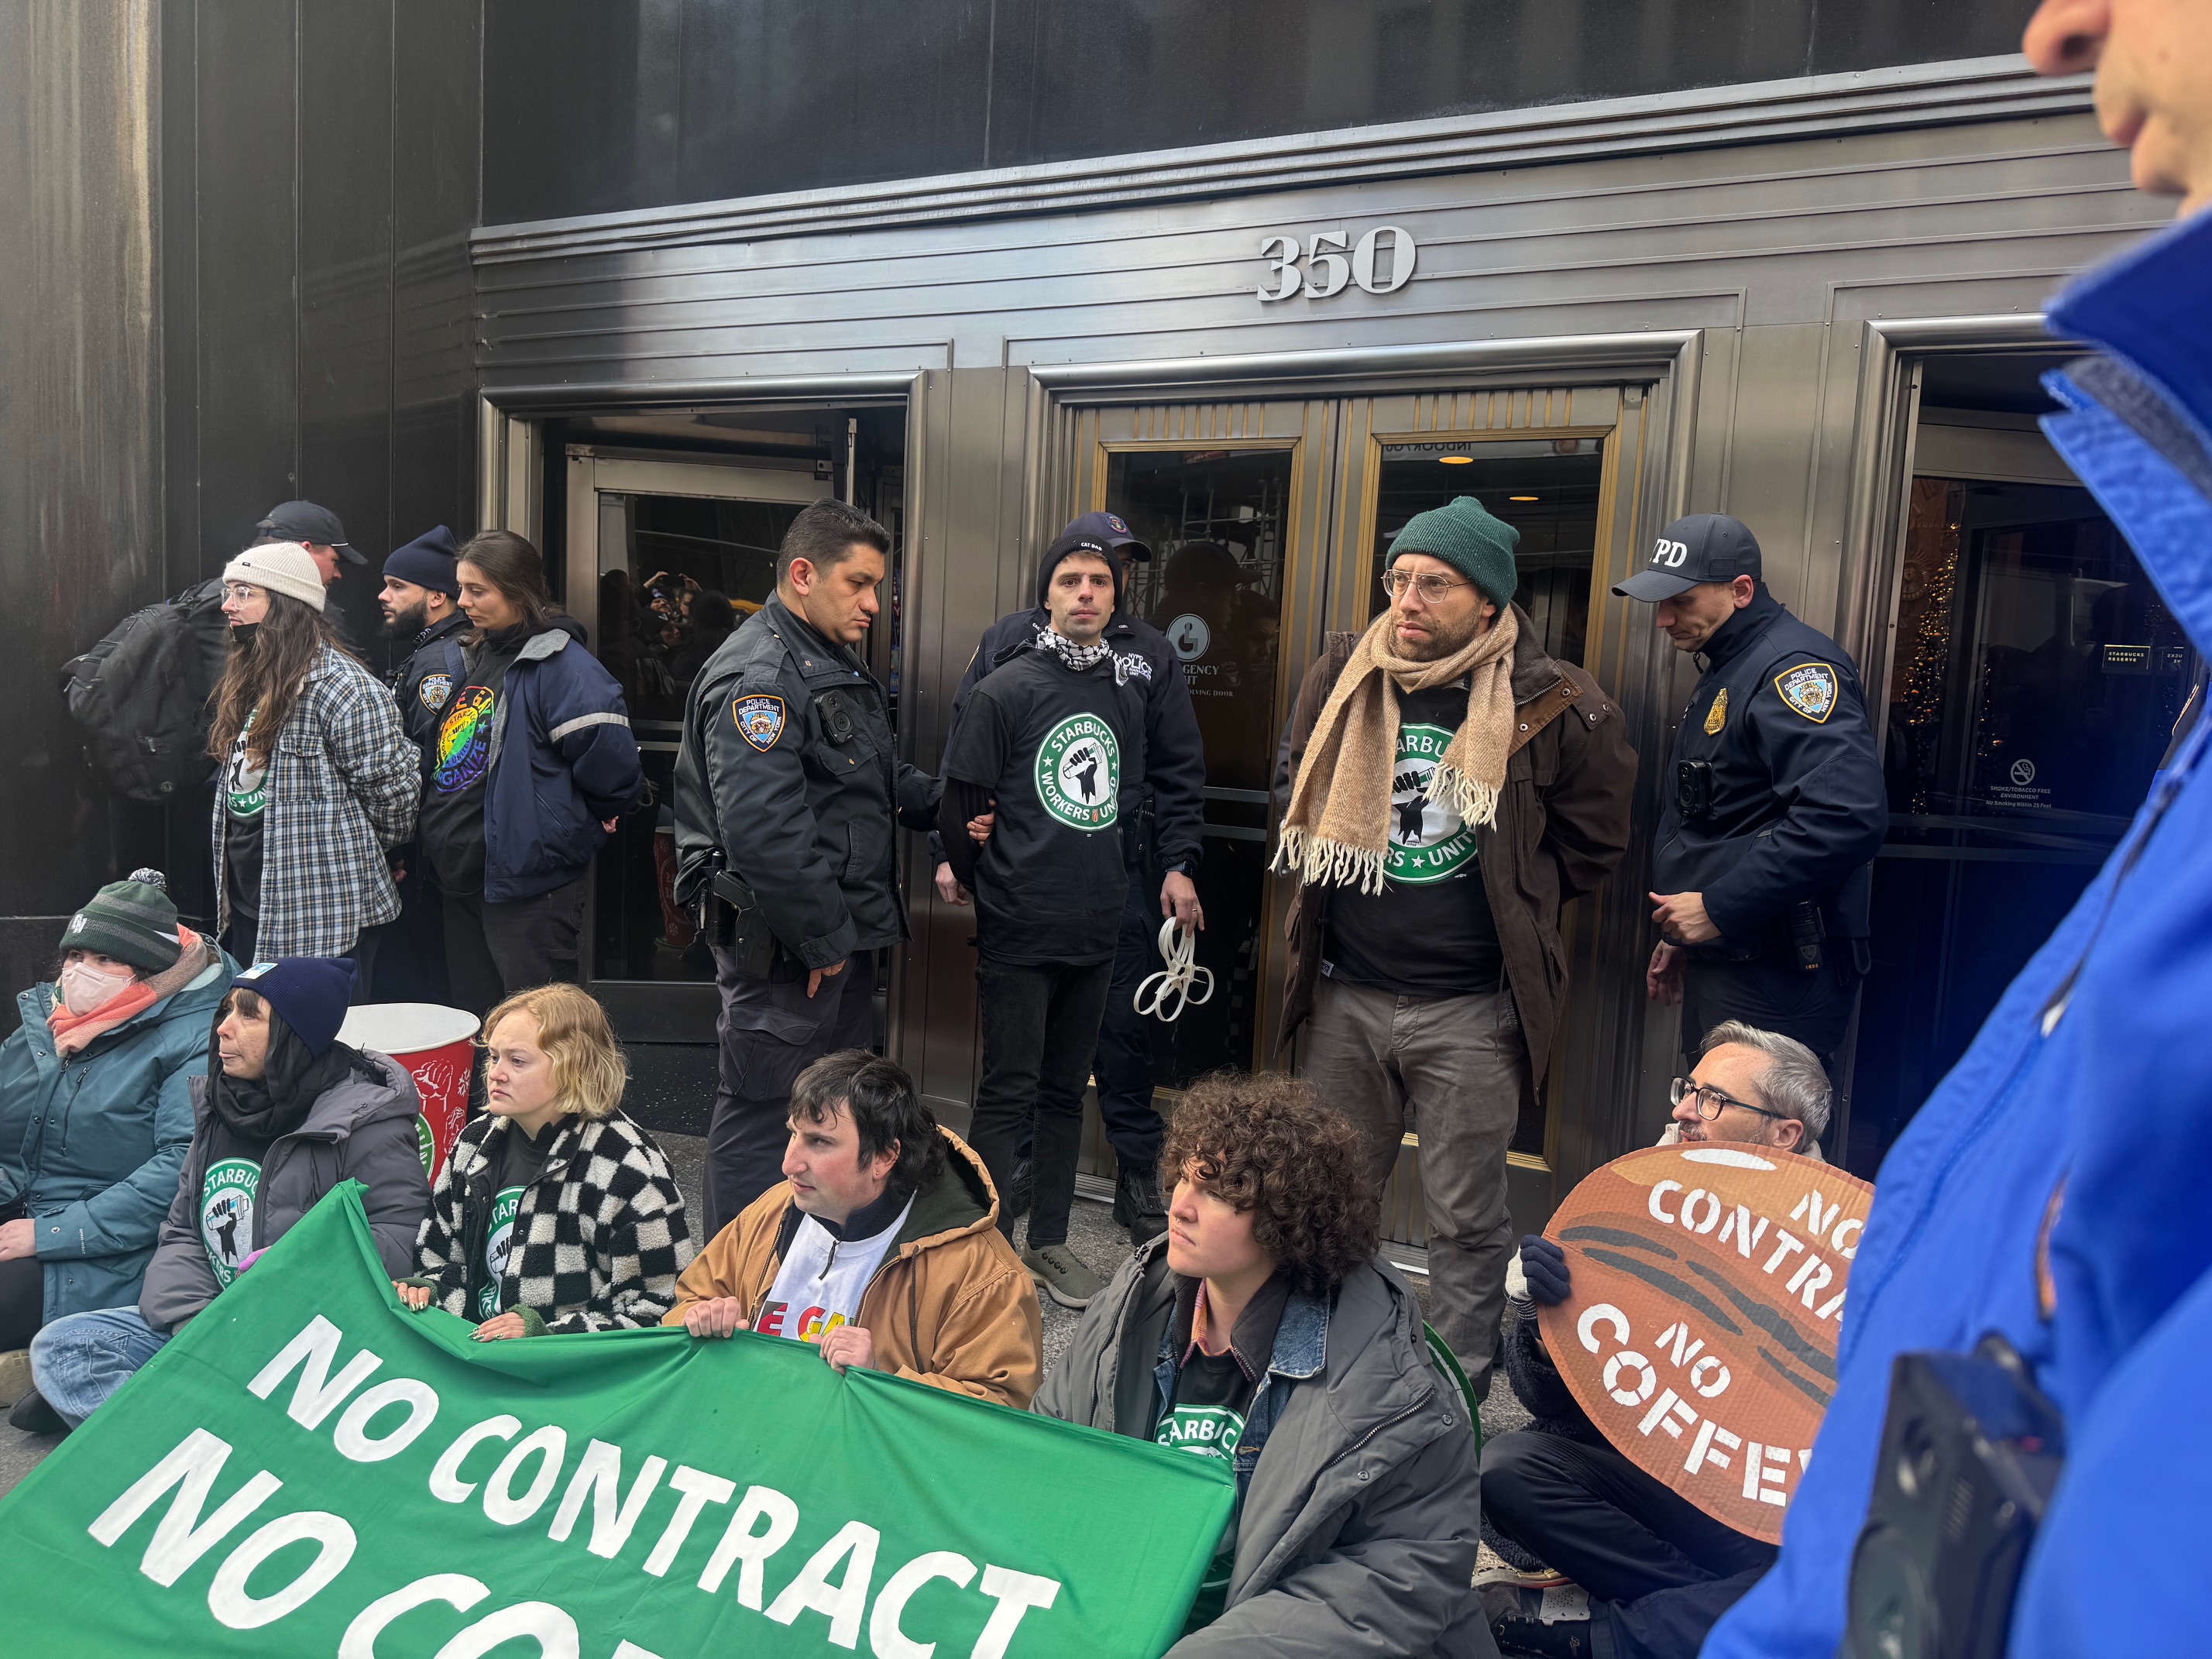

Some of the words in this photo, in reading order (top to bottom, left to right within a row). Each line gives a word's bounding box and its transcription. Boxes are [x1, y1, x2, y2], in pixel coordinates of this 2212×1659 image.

[1257, 225, 1416, 301] 350
[1091, 543, 1103, 551] DAD
[1649, 538, 1687, 568] PD
[1118, 657, 1152, 676] OLICE
[1128, 652, 1144, 661] NYPD
[1182, 664, 1220, 675] GENCY
[1790, 668, 1817, 680] POLICE
[422, 681, 453, 689] DEPARTMENT
[1784, 673, 1829, 691] DEPARTMENT
[738, 703, 781, 716] DEPARTMENT
[1788, 696, 1802, 708] CITY
[1821, 699, 1830, 713] NEW
[740, 721, 750, 735] CITY
[765, 732, 776, 744] NEW
[773, 716, 782, 731] YORK
[1051, 720, 1115, 757] STARBUCKS
[431, 740, 486, 786] ORGANIZE
[452, 737, 472, 764] UNITED
[1041, 770, 1090, 821] WORKERS
[1427, 831, 1475, 867] UNIT
[1789, 1189, 1865, 1259] NO
[204, 1243, 232, 1283] KERS
[1654, 1321, 1731, 1398] NO
[247, 1314, 440, 1462] NO
[1577, 1303, 1813, 1507] COFFE
[88, 1428, 358, 1630] NO
[429, 1414, 1062, 1659] CONTRACT
[338, 1573, 666, 1659] CO
